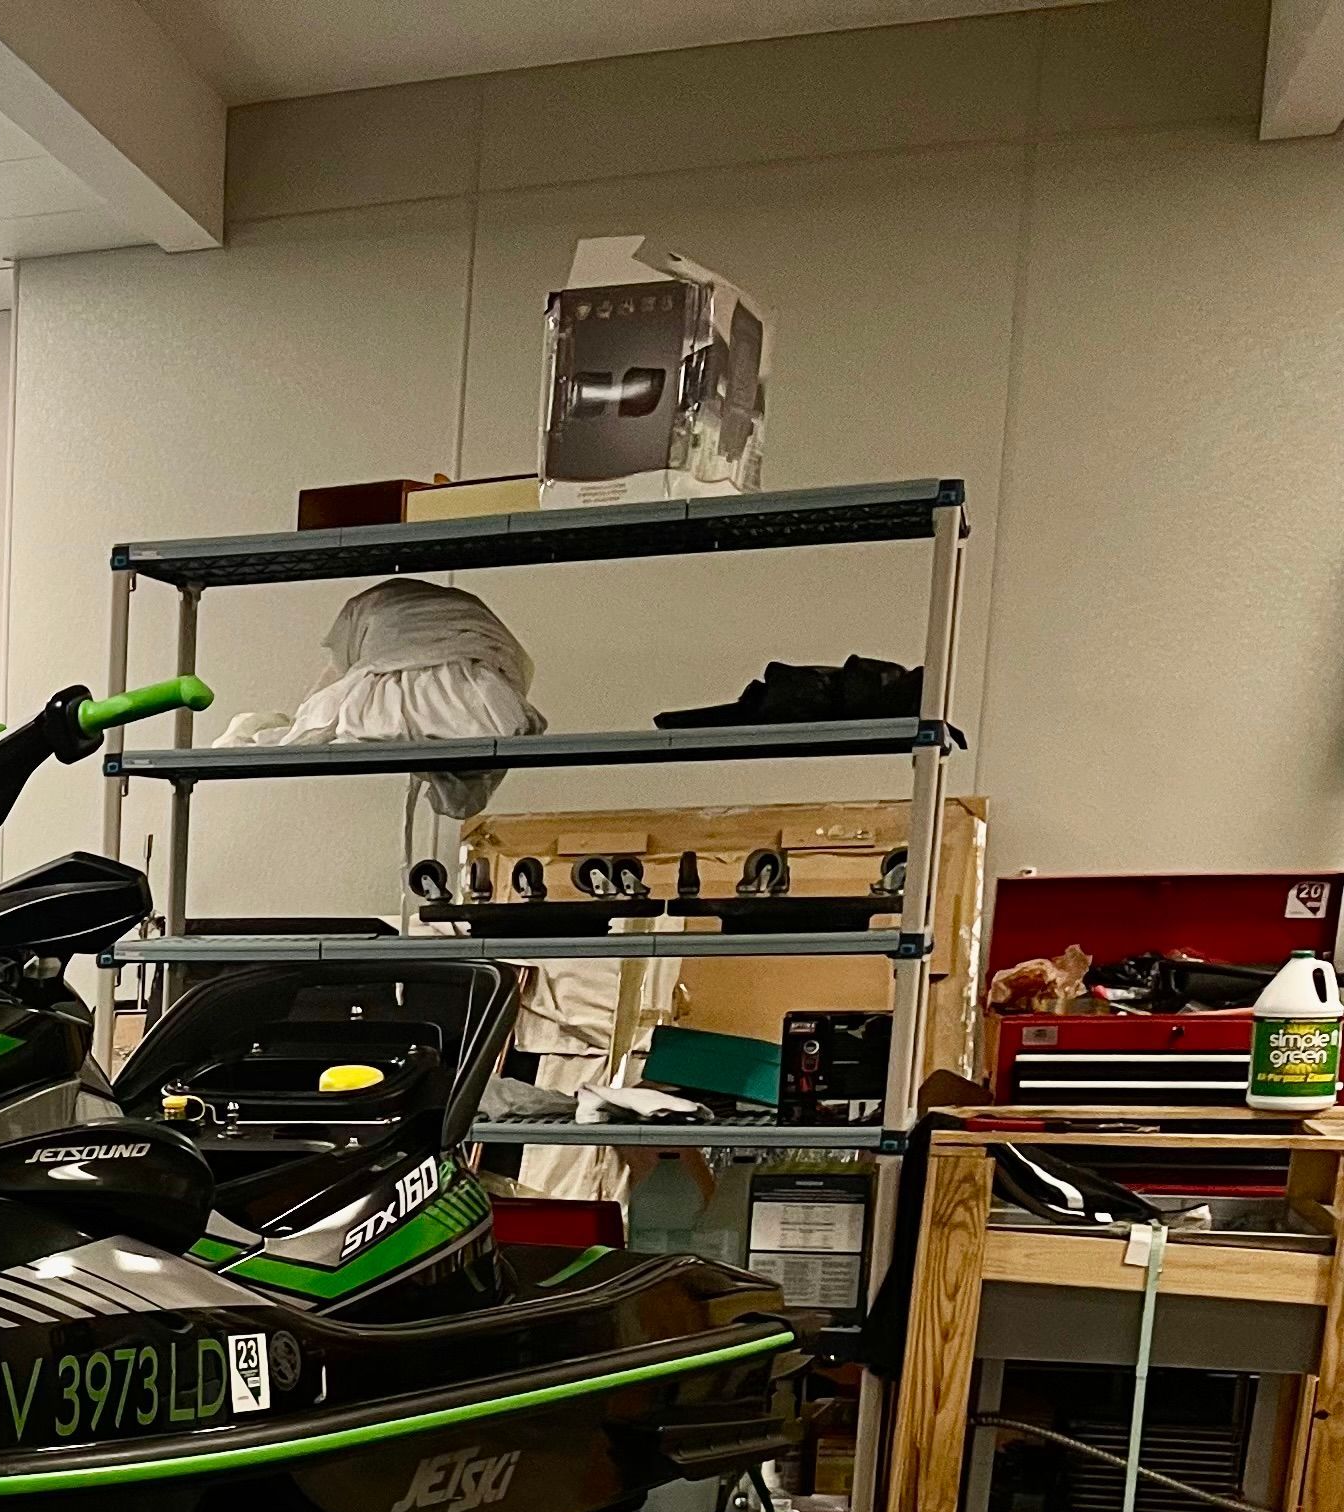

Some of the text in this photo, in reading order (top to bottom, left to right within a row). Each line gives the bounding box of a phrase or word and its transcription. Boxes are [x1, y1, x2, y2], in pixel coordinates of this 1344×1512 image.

[1298, 883, 1322, 899] 20
[1269, 1029, 1330, 1052] simple
[1269, 1049, 1328, 1068] green
[24, 1143, 152, 1165] JETSOUND
[340, 1155, 439, 1259] STX 160
[236, 1339, 259, 1370] 23
